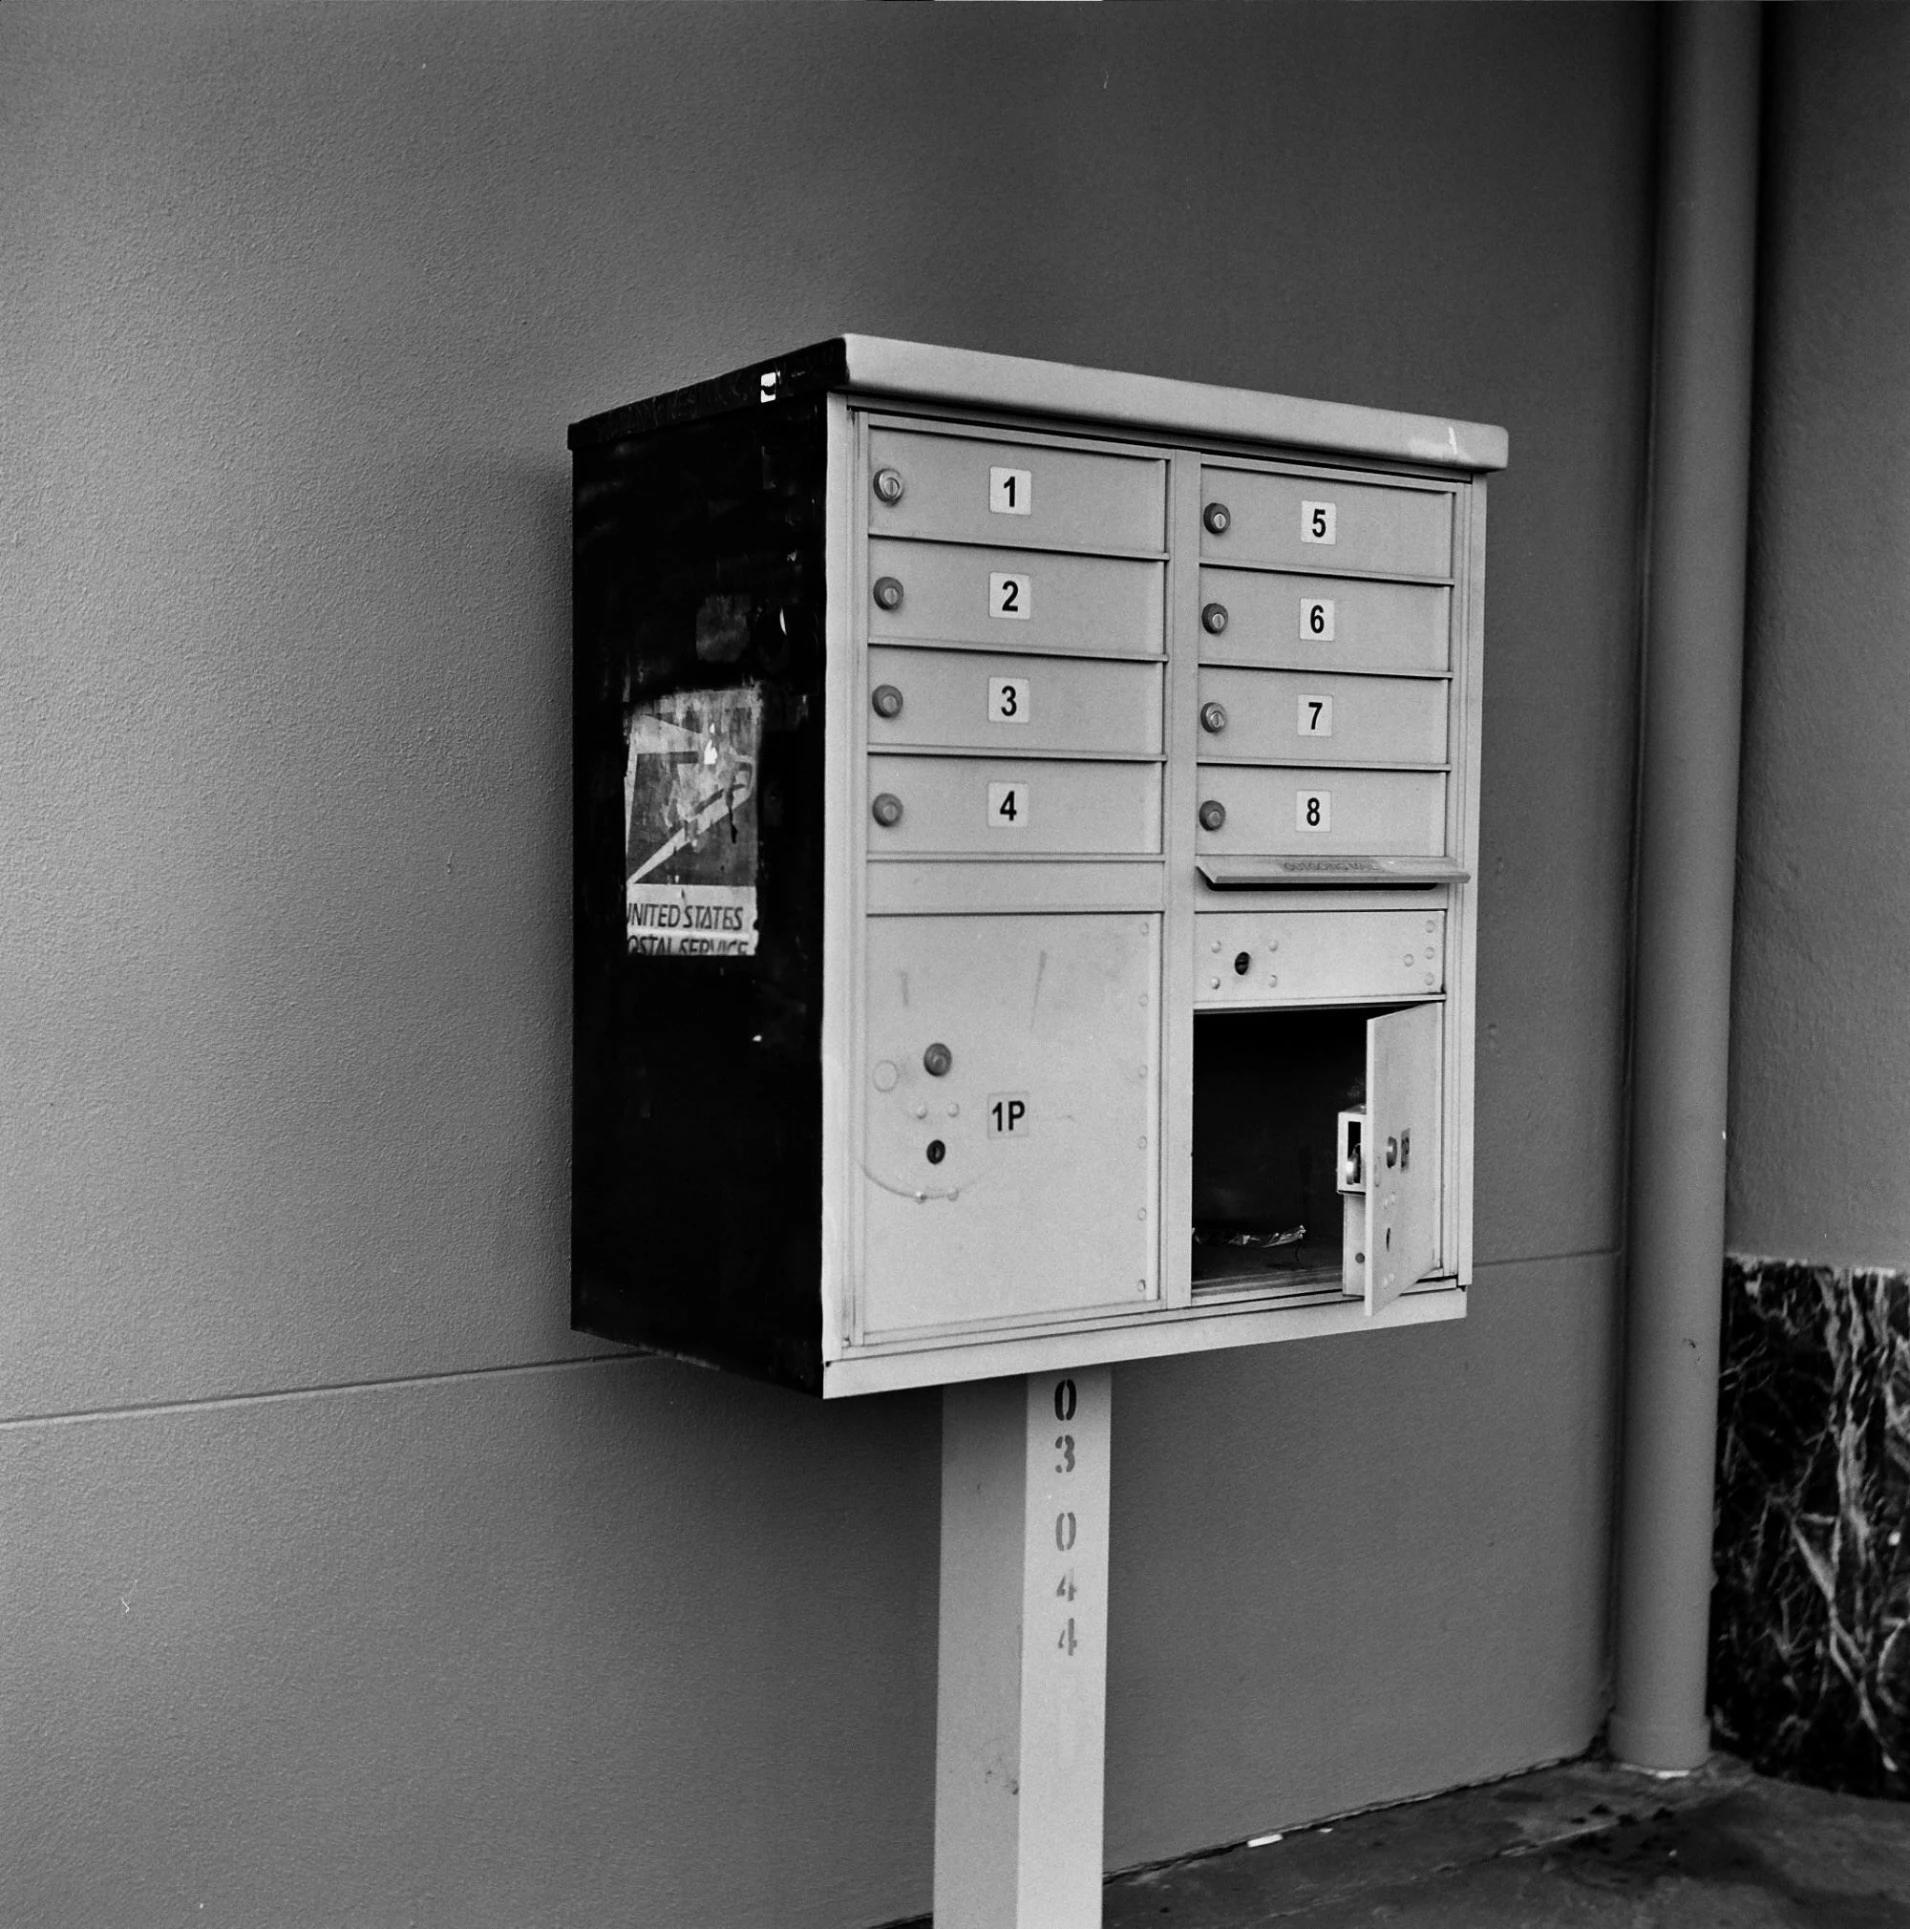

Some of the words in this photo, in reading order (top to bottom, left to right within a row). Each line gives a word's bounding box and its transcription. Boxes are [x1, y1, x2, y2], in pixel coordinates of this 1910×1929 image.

[1003, 476, 1016, 508] 1
[1312, 508, 1327, 538] 5
[1002, 580, 1018, 612] 2
[1311, 604, 1325, 634] 6
[1001, 685, 1017, 717] 3
[1308, 701, 1323, 730] 7
[999, 790, 1016, 821] 4
[1306, 797, 1321, 827] 8
[683, 905, 744, 931] STATES
[993, 1101, 1025, 1132] 1P
